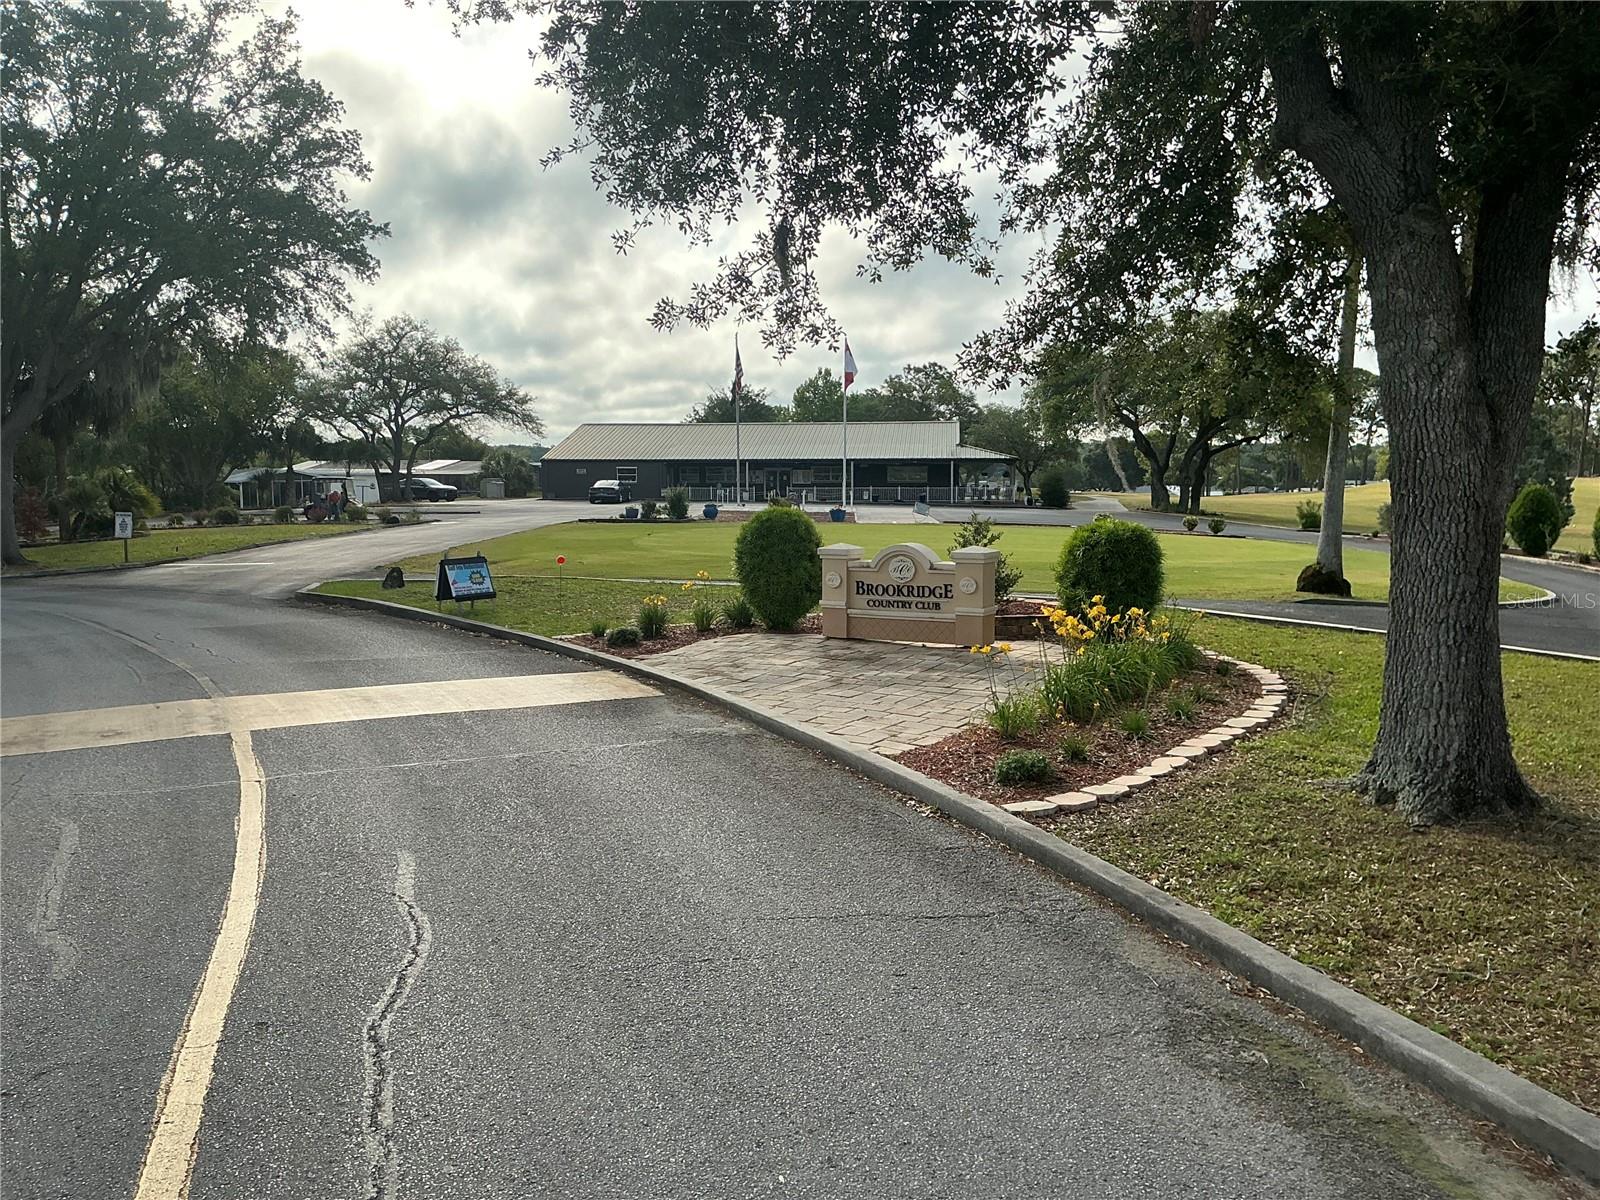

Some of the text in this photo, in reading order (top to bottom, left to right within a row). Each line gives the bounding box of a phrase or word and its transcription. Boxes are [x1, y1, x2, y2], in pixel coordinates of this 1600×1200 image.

[855, 580, 954, 600] BROOKRIDGE
[866, 599, 942, 611] COUNTRY CLUB
